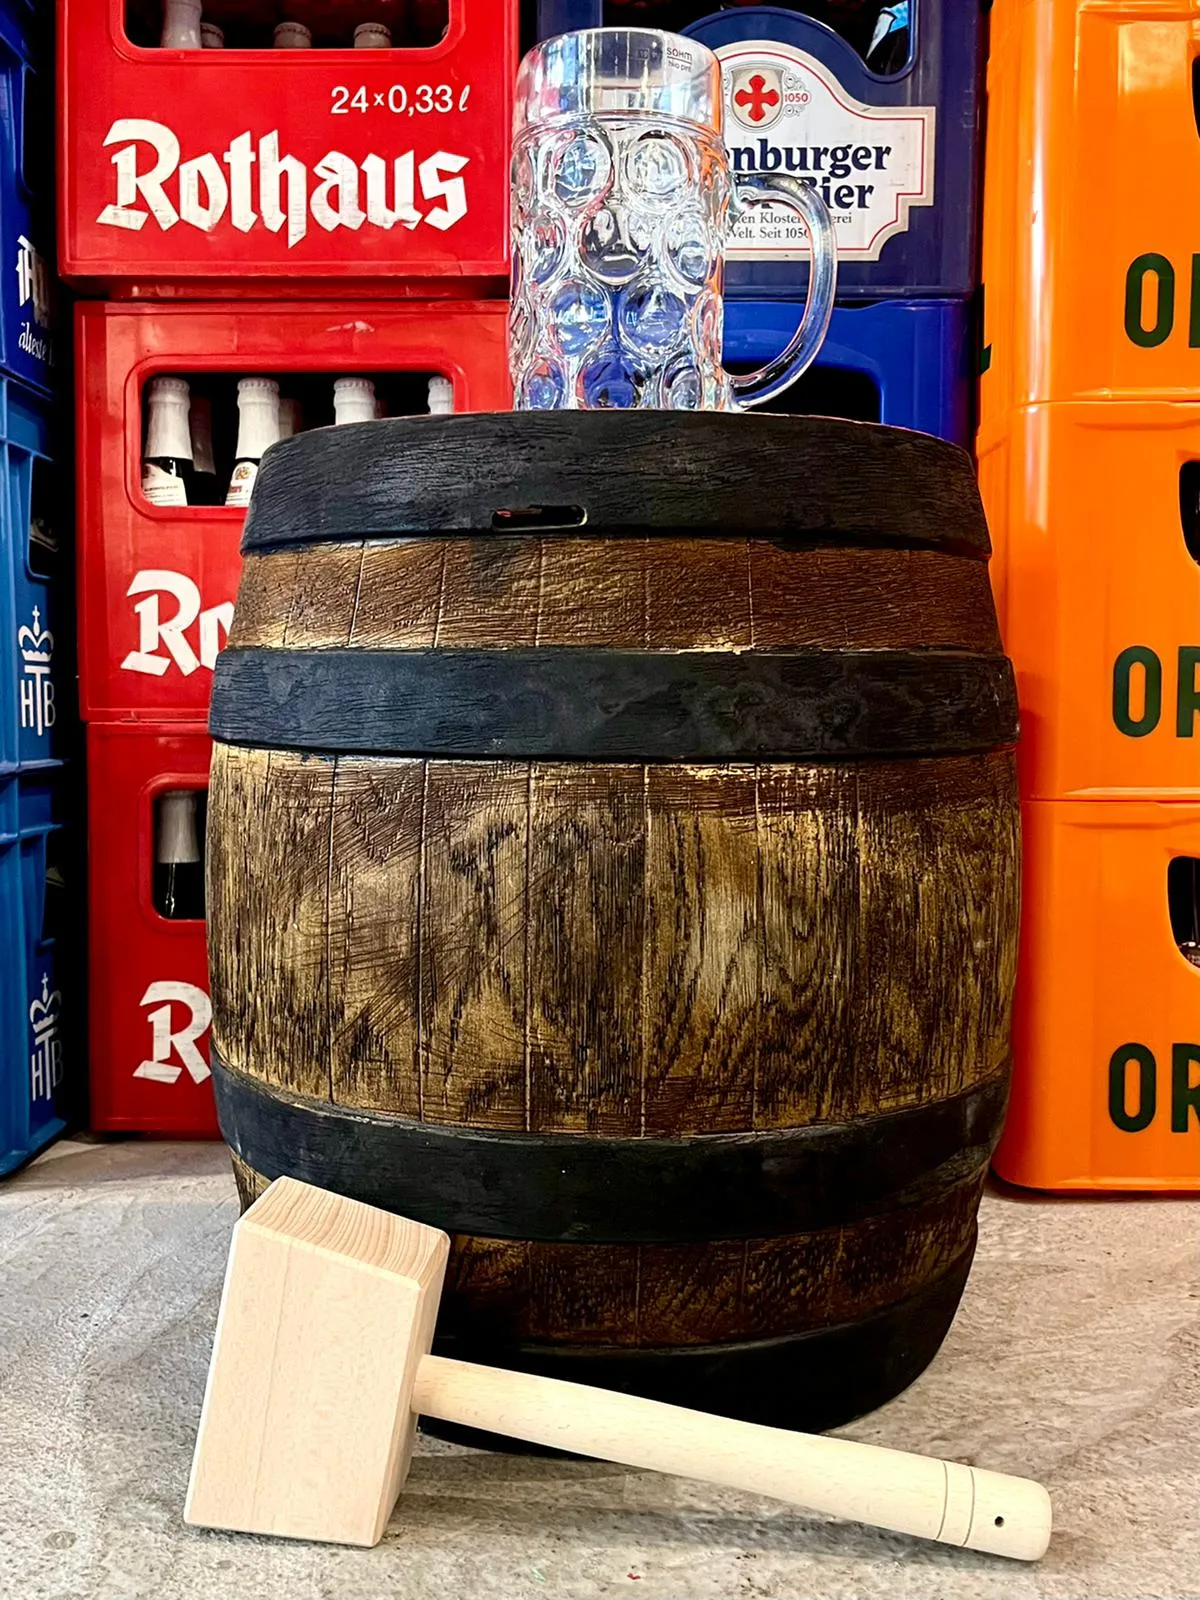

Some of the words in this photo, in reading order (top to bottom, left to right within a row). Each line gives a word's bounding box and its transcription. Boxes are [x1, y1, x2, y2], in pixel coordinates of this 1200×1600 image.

[784, 92, 809, 103] 1050
[725, 138, 892, 179] nburger
[96, 118, 470, 249] Rothaus
[760, 227, 781, 239] Seit
[1124, 252, 1200, 348] O
